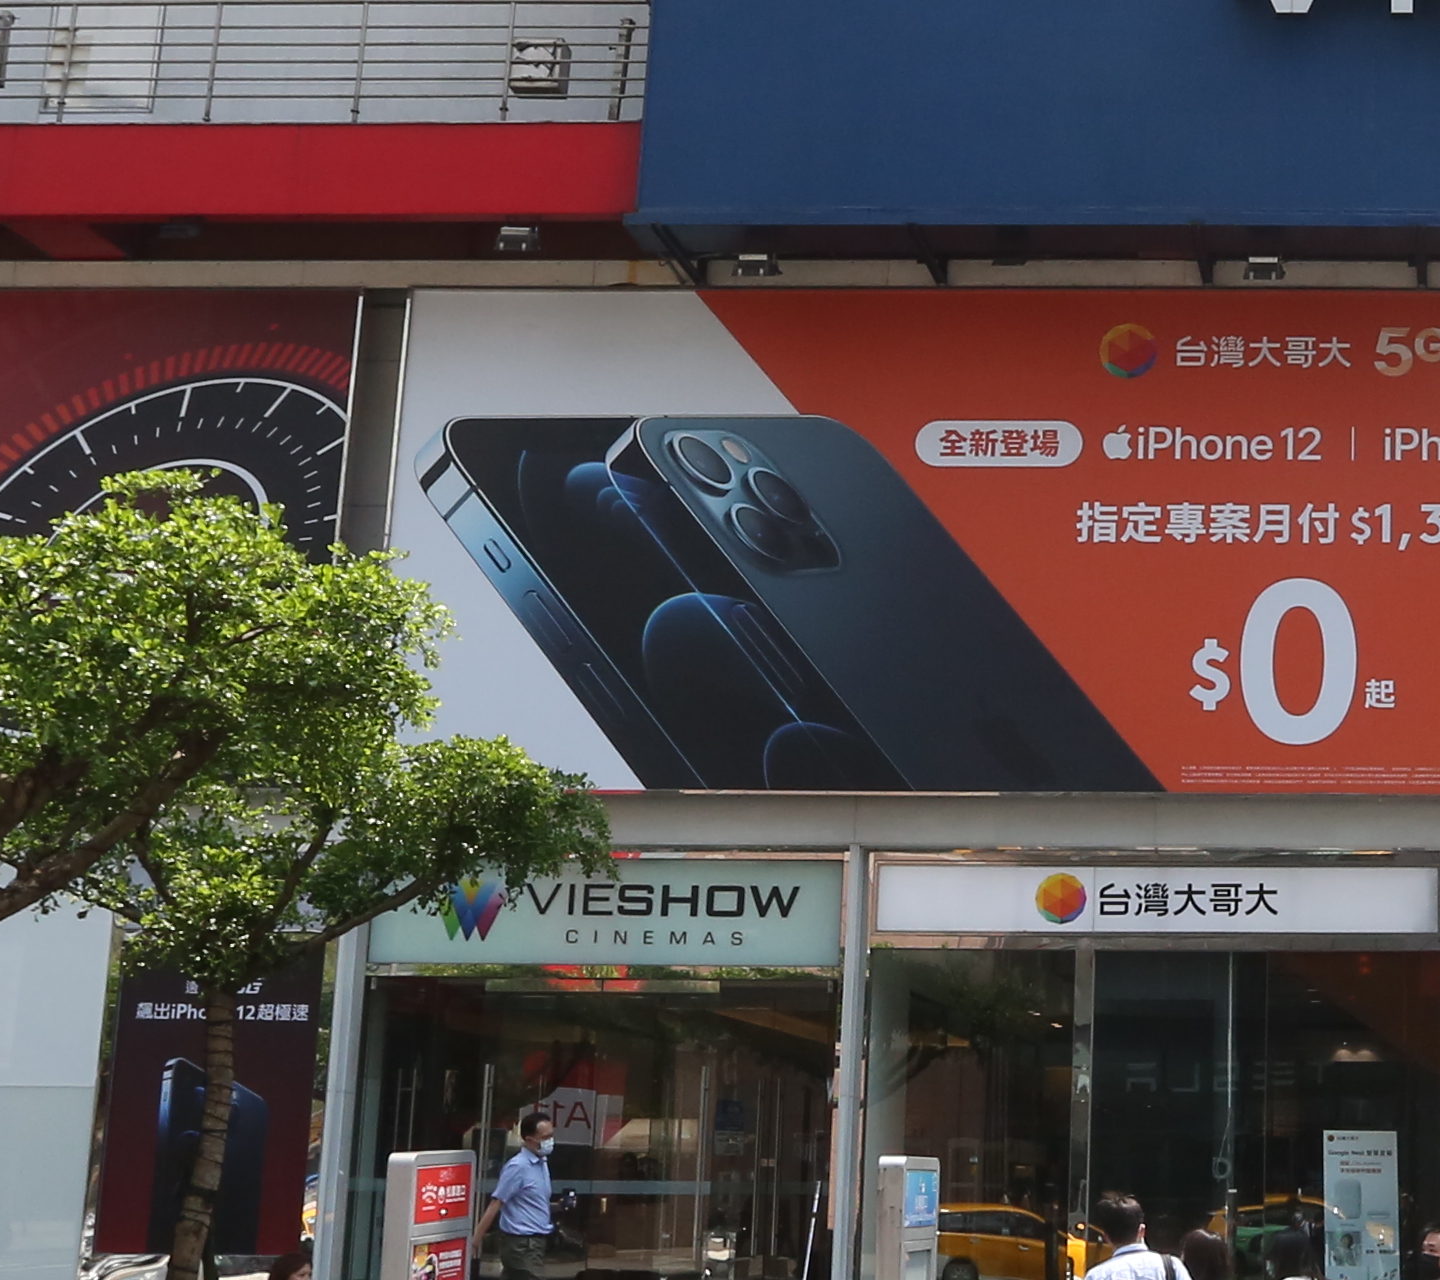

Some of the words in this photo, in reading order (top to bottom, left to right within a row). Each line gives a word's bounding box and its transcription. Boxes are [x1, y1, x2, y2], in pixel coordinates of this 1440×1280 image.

[1174, 334, 1353, 370] 台灣大哥大
[938, 428, 1061, 459] 全新登場
[1136, 426, 1275, 462] iPhone
[1279, 428, 1322, 461] 12
[1075, 501, 1340, 545] 指定專案月付
[1364, 678, 1396, 710] 起
[526, 882, 801, 919] VIESHOW
[1097, 881, 1279, 918] 台灣大哥大
[564, 929, 745, 947] CINEMAS
